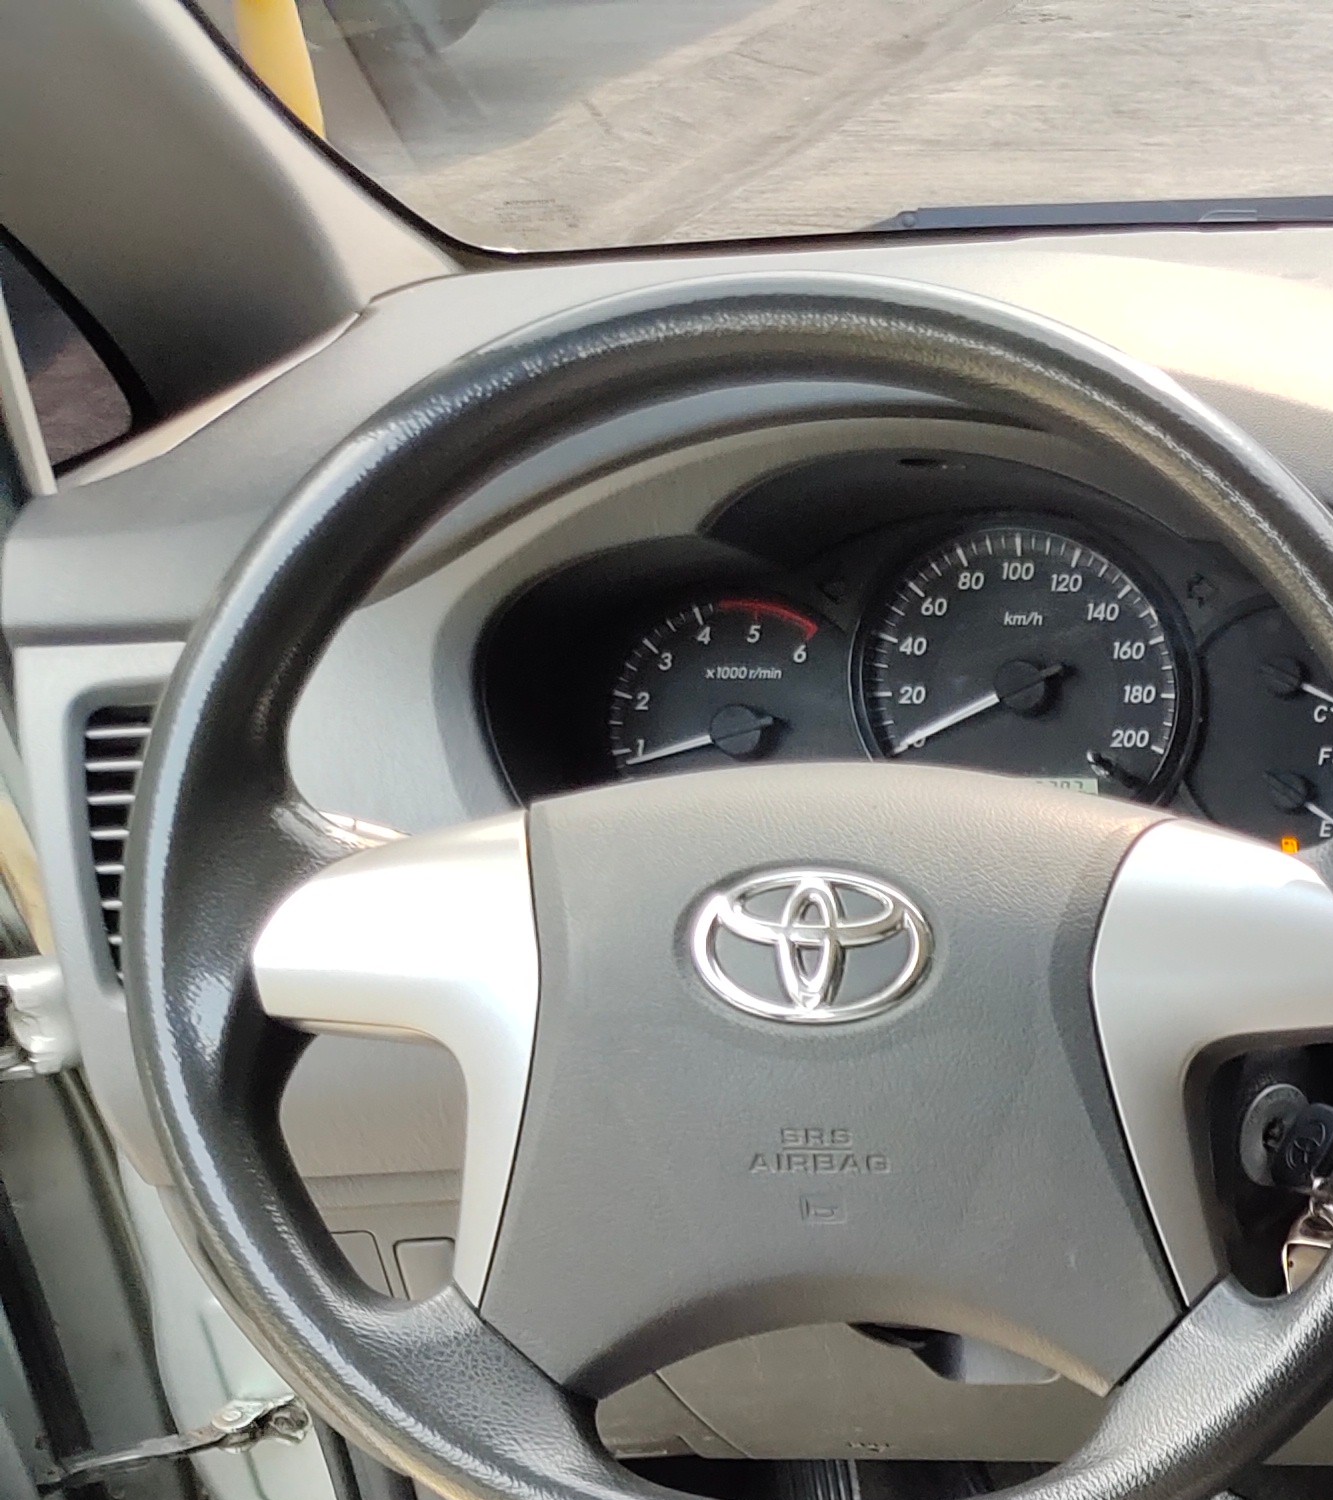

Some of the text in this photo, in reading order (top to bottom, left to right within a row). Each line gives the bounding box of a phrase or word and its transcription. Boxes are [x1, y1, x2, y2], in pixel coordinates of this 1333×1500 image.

[1001, 562, 1034, 581] 100
[957, 572, 984, 591] 80
[1050, 574, 1082, 592] 120
[921, 598, 948, 616] 60
[1086, 603, 1119, 622] 140
[1003, 611, 1043, 627] km/h
[696, 626, 711, 645] 4
[746, 625, 761, 643] 5
[793, 644, 807, 663] 6
[899, 637, 927, 655] 40
[1112, 641, 1145, 660] 160
[658, 652, 672, 671] 3
[705, 665, 782, 680] x1000 r/min
[635, 692, 650, 710] 2
[898, 686, 926, 704] 20
[1123, 685, 1156, 703] 180
[1314, 705, 1328, 722] C
[636, 739, 645, 757] 1
[1110, 730, 1149, 748] 200
[1318, 747, 1333, 765] F
[1319, 820, 1332, 838] E
[780, 1127, 852, 1146] SRS
[749, 1153, 892, 1174] AIRBAG
